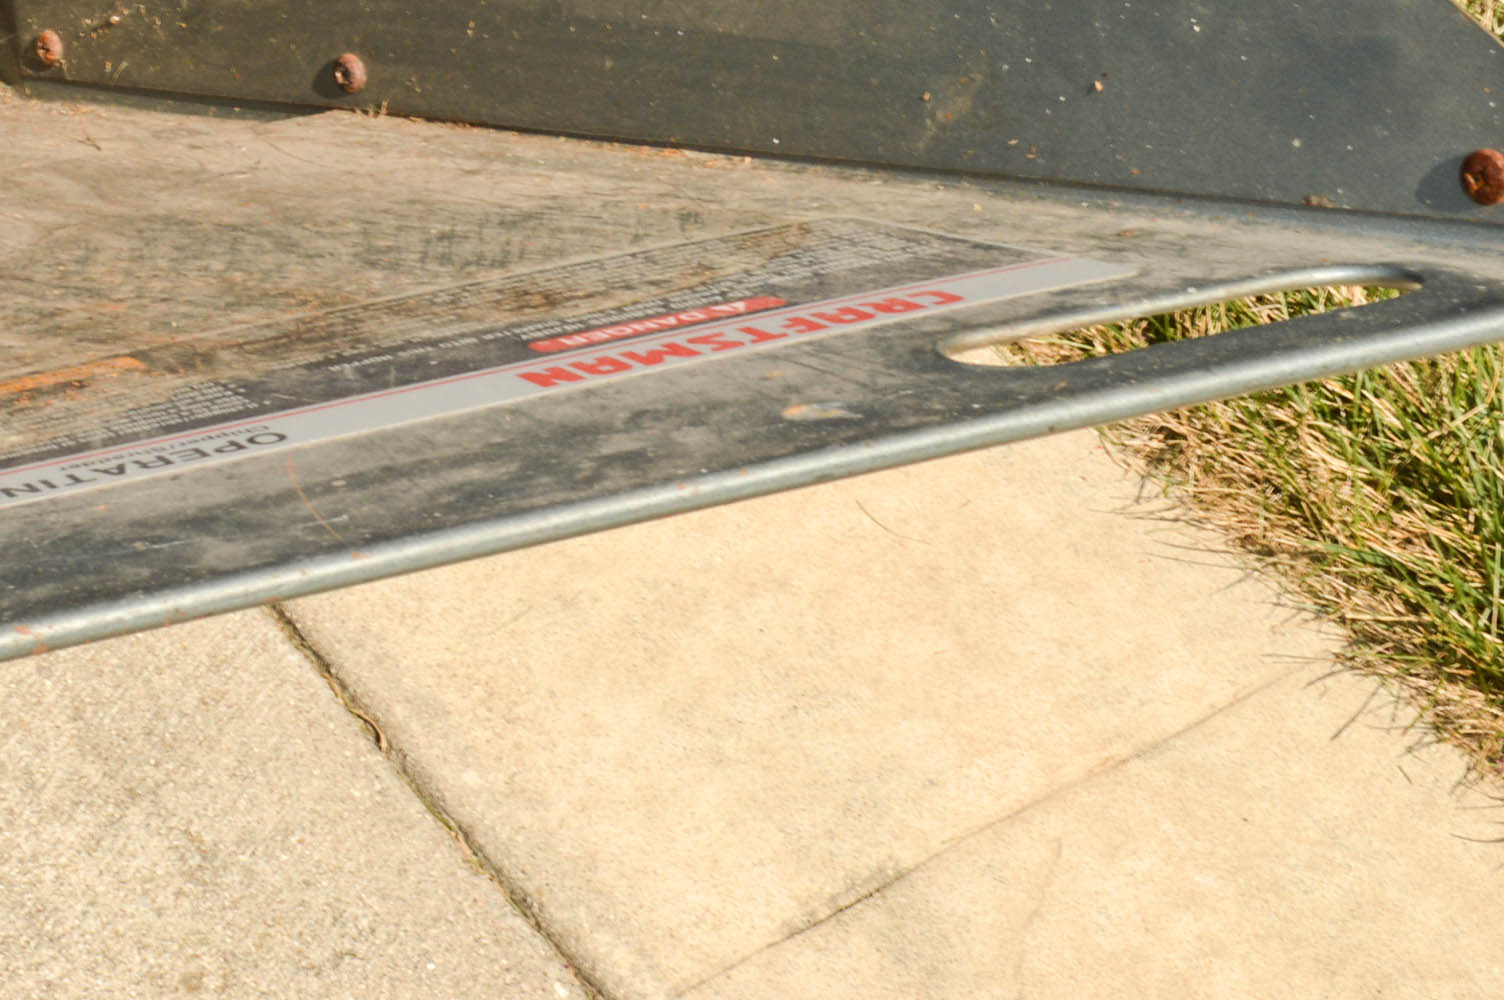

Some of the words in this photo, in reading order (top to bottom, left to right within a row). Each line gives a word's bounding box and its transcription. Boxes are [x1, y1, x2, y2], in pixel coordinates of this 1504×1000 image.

[516, 289, 964, 388] CRAFTSMAN
[561, 312, 705, 345] DANGER
[60, 426, 269, 471] Chipper/Shredder
